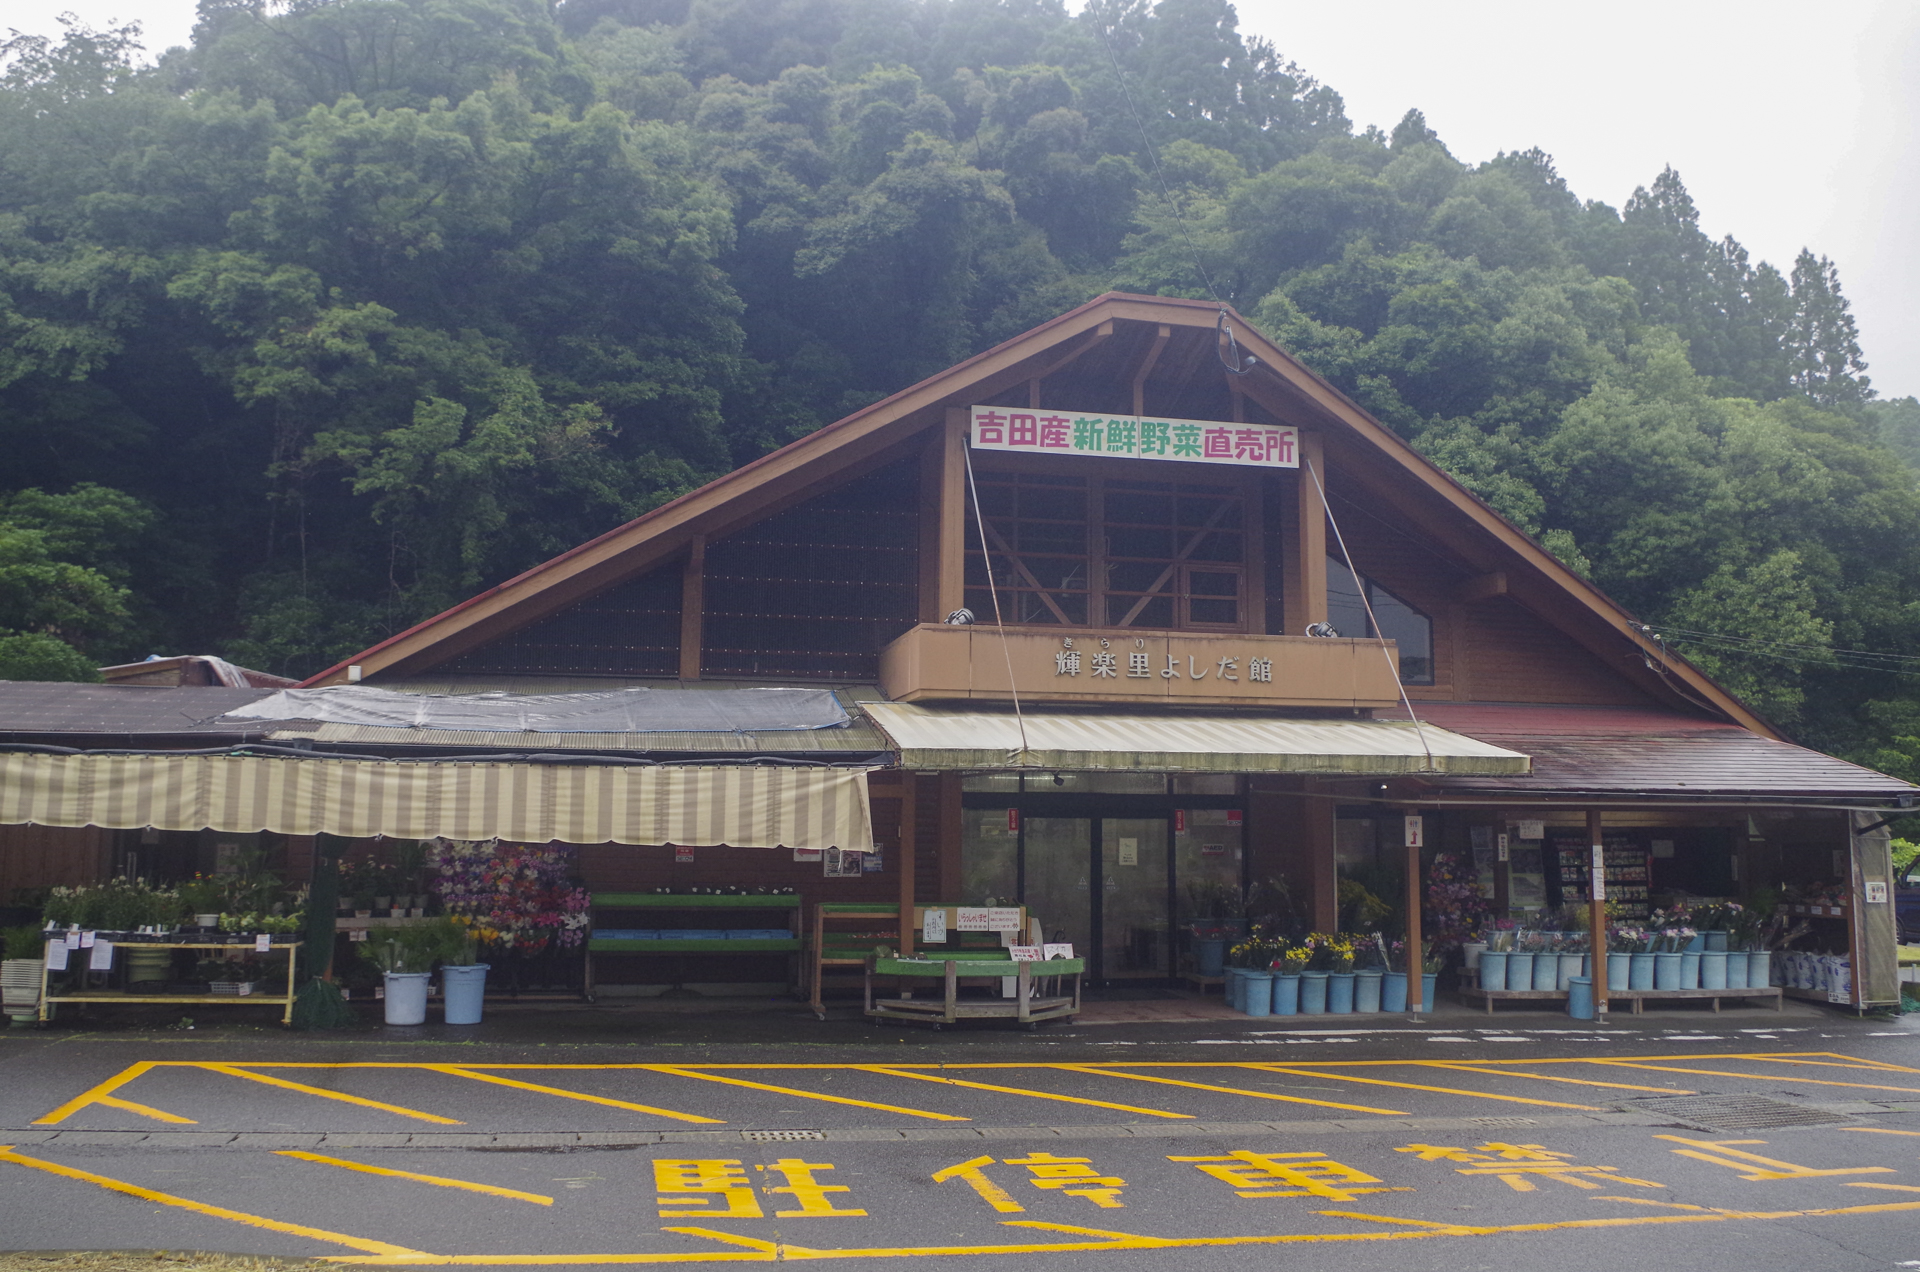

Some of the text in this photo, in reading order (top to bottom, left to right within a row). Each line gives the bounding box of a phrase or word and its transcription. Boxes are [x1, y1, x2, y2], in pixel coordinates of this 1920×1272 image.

[975, 410, 1295, 463] 吉田産新鮮野菜直売所
[1055, 650, 1273, 682] 輝楽里よしだ館
[958, 913, 987, 923] いらっしゃいませ
[652, 1135, 1898, 1218] 駐停車禁止
